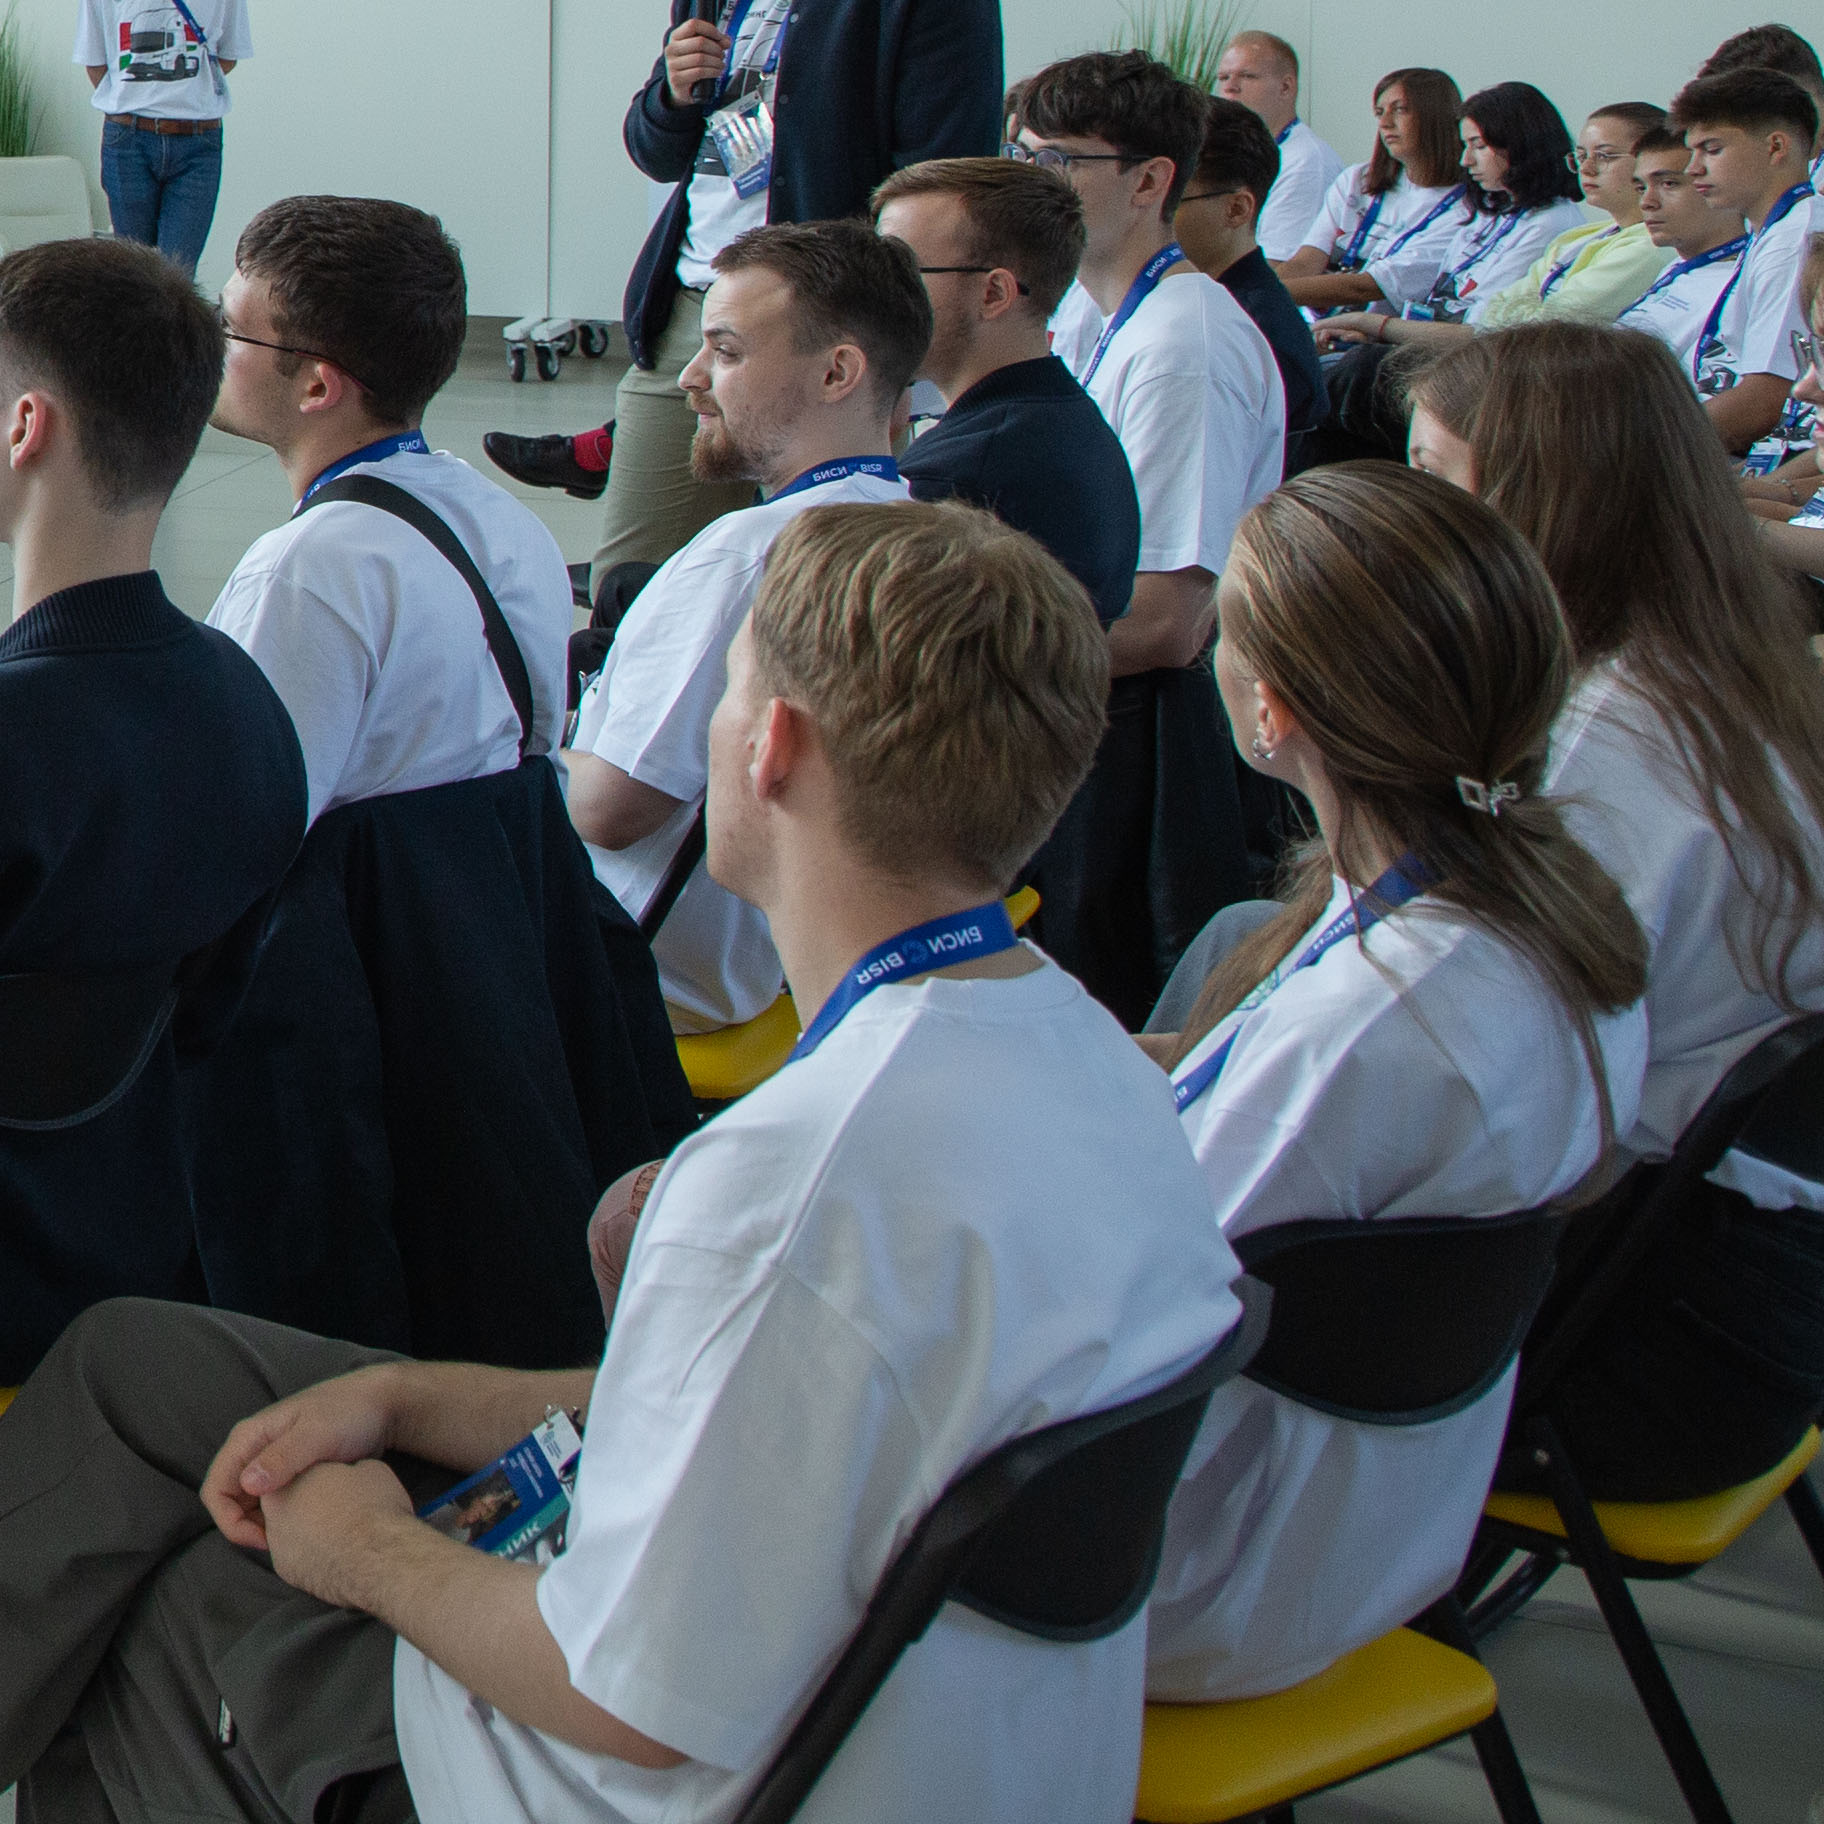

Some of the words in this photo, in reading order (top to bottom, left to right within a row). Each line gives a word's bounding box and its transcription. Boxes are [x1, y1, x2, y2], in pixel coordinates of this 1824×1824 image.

[812, 466, 847, 482] БИСИ
[926, 925, 983, 954] БИСИ
[855, 951, 905, 985] BISR
